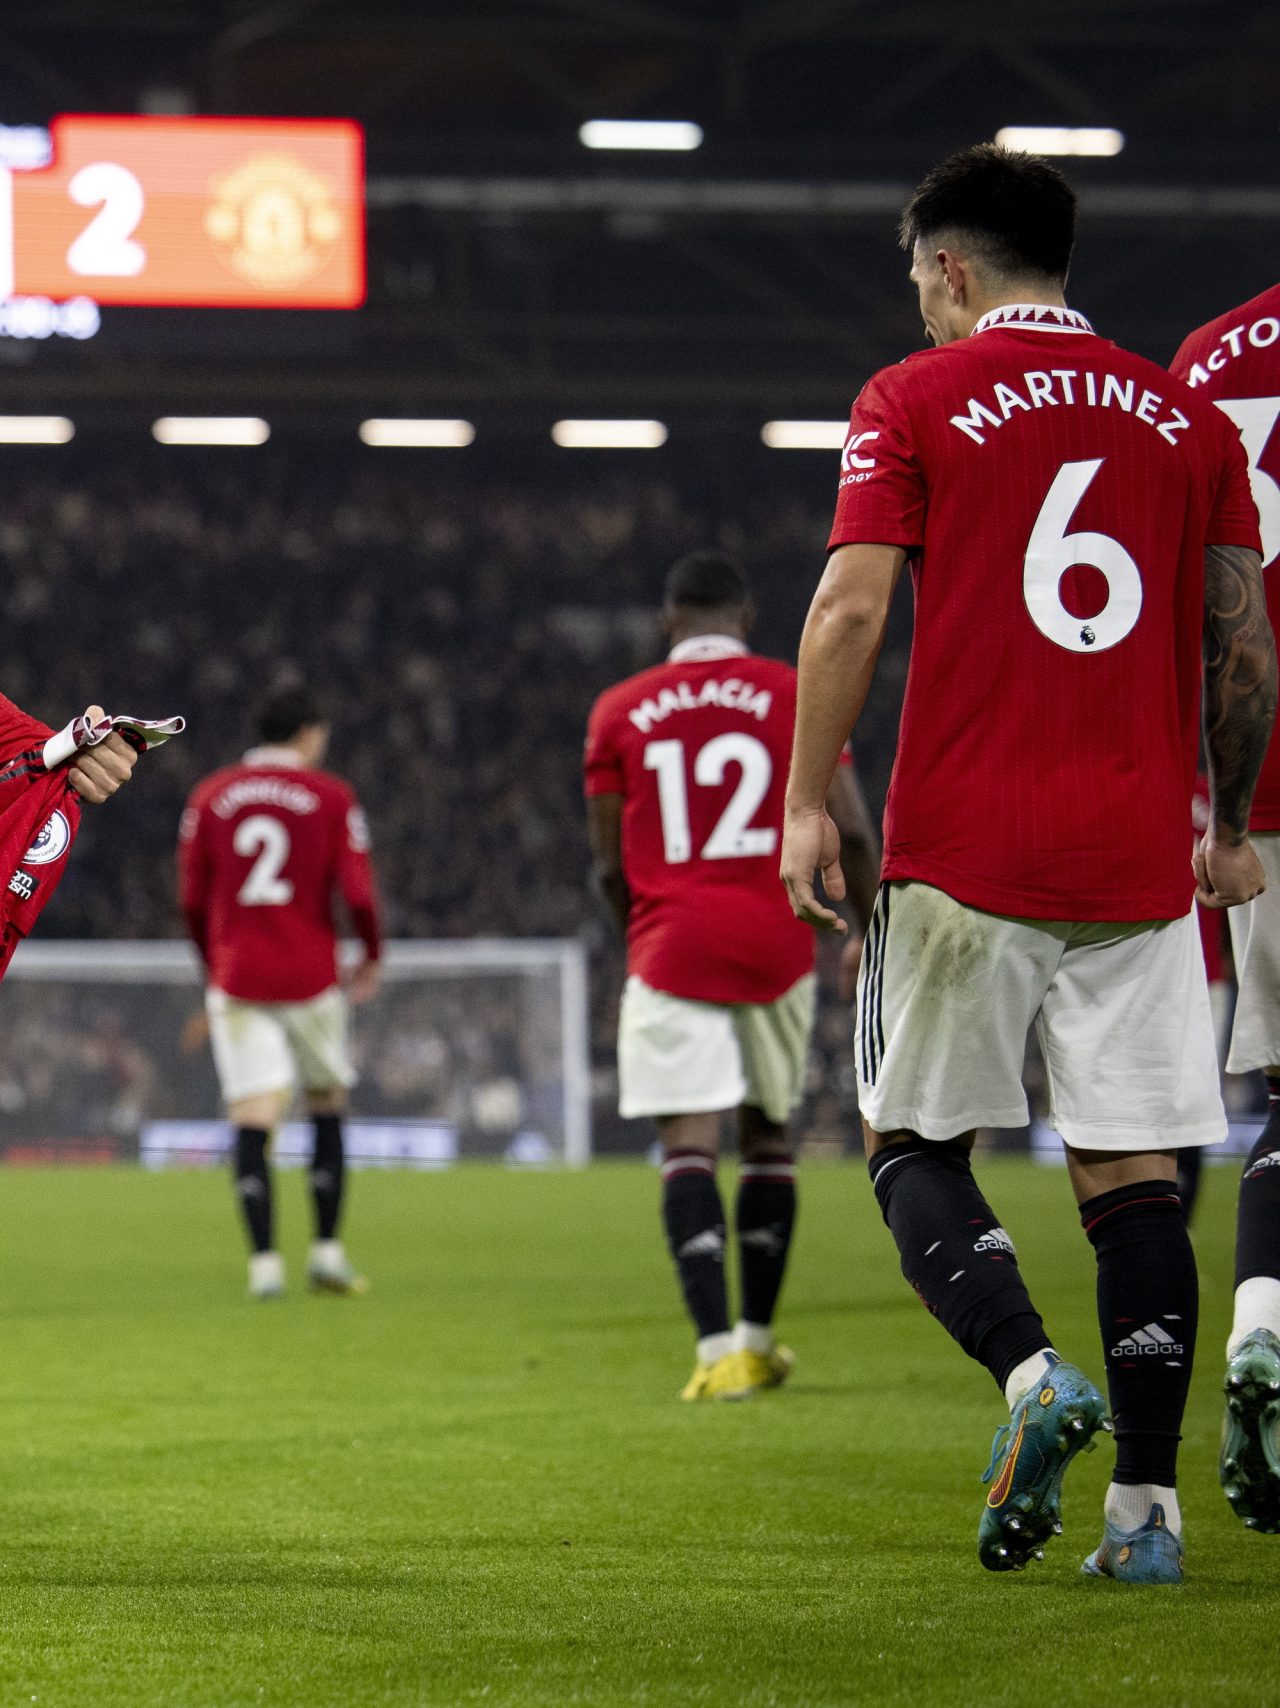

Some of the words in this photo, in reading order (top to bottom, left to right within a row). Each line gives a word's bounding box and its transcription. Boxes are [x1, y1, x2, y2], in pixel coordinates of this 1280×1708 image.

[66, 162, 146, 276] 2
[949, 369, 1191, 446] MARTINEZ
[1023, 457, 1144, 653] 6
[628, 677, 773, 734] MALACIA
[642, 731, 778, 865] 12
[233, 813, 295, 907] 2
[1111, 1341, 1183, 1357] adidas
